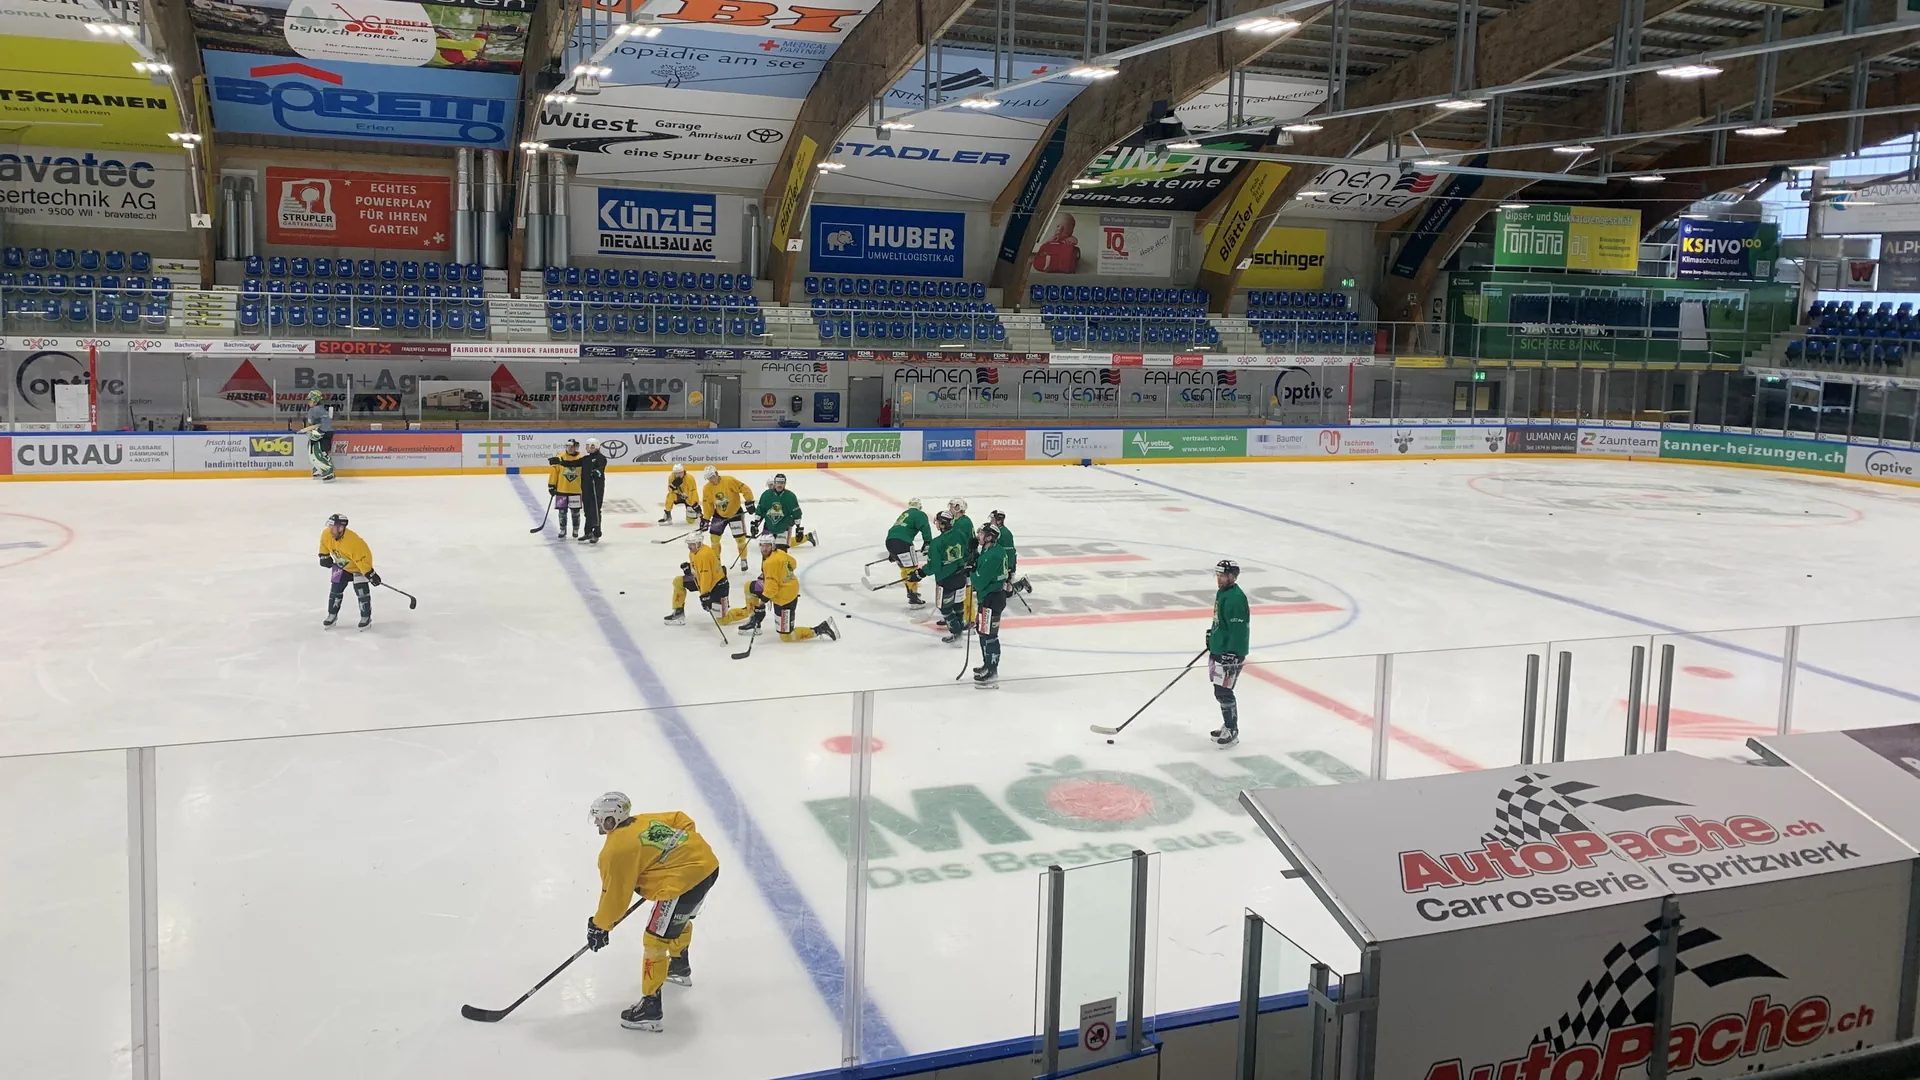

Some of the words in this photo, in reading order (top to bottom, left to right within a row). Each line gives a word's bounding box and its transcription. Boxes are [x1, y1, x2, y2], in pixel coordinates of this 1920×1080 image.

[289, 24, 350, 36] bsjw.ch
[357, 33, 405, 41] FOREGA
[780, 46, 826, 56] PARTNER
[782, 40, 828, 50] MEDICAL
[717, 54, 758, 69] am
[766, 57, 806, 73] see
[540, 109, 638, 134] Wüest
[655, 120, 702, 132] Garage
[688, 130, 742, 142] Amriswil
[623, 147, 660, 159] eine
[662, 149, 701, 163] Spur
[704, 152, 758, 165] besser
[831, 142, 1011, 166] STADLER
[1170, 153, 1240, 175] AG
[370, 183, 417, 194] ECHTES
[121, 191, 157, 209] AG
[355, 196, 432, 209] POWERPLAY
[48, 206, 74, 217] 9500
[79, 207, 94, 217] Wil
[104, 210, 157, 221] bravatec.ch
[282, 212, 333, 223] STRUPLER
[360, 208, 384, 220] FÜR
[388, 211, 427, 222] IHREN
[1505, 210, 1534, 222] Gipser-
[1536, 211, 1551, 222] und
[368, 223, 419, 235] GARTEN
[601, 233, 690, 252] METALLBAU
[693, 238, 713, 252] AG
[867, 224, 956, 250] HUBER
[867, 251, 940, 262] UMWELTLOGISTIK
[942, 255, 955, 263] AG
[1251, 250, 1324, 270] schinger
[1682, 256, 1719, 265] Klimaschutz
[1720, 257, 1740, 266] Diesel
[23, 338, 59, 350] axpo
[76, 338, 111, 350] axpo
[128, 339, 162, 351] axpo
[452, 346, 493, 354] FAIRDRUCK
[496, 346, 536, 354] FAIRDRUCK
[538, 346, 578, 354] FAIRDRUCK
[1520, 338, 1565, 350] SICHERE
[226, 392, 267, 401] HASLER
[515, 394, 551, 402] HASLER
[994, 392, 1008, 401] lang
[1045, 392, 1058, 401] lang
[1143, 392, 1157, 401] lang
[561, 404, 619, 412] WEINFELDEN
[634, 434, 675, 445] Wüest
[1066, 437, 1089, 445] FMT
[1210, 434, 1239, 442] vorwärts.
[1276, 434, 1303, 443] Baumer
[1526, 432, 1562, 442] ULMANN
[1563, 432, 1577, 442] AG
[1599, 436, 1658, 447] Zaunteam
[204, 440, 228, 448] frisch
[250, 438, 293, 456] Volg
[828, 445, 844, 453] Team
[942, 439, 973, 448] HUBER
[17, 444, 123, 467] CURAU
[789, 453, 834, 461] Weinfelden
[841, 452, 902, 461] www.topsan.ch
[1663, 439, 1844, 464] tanner-heizungen.ch
[204, 460, 294, 470] landimittelthurgau.ch
[688, 455, 704, 463] Spur
[1870, 460, 1913, 476] optive
[866, 858, 971, 889] Das
[980, 841, 1138, 876] Beste
[1150, 829, 1246, 853] aus
[1416, 863, 1650, 923] Carrosserie
[1666, 838, 1862, 888] Spritzwerk
